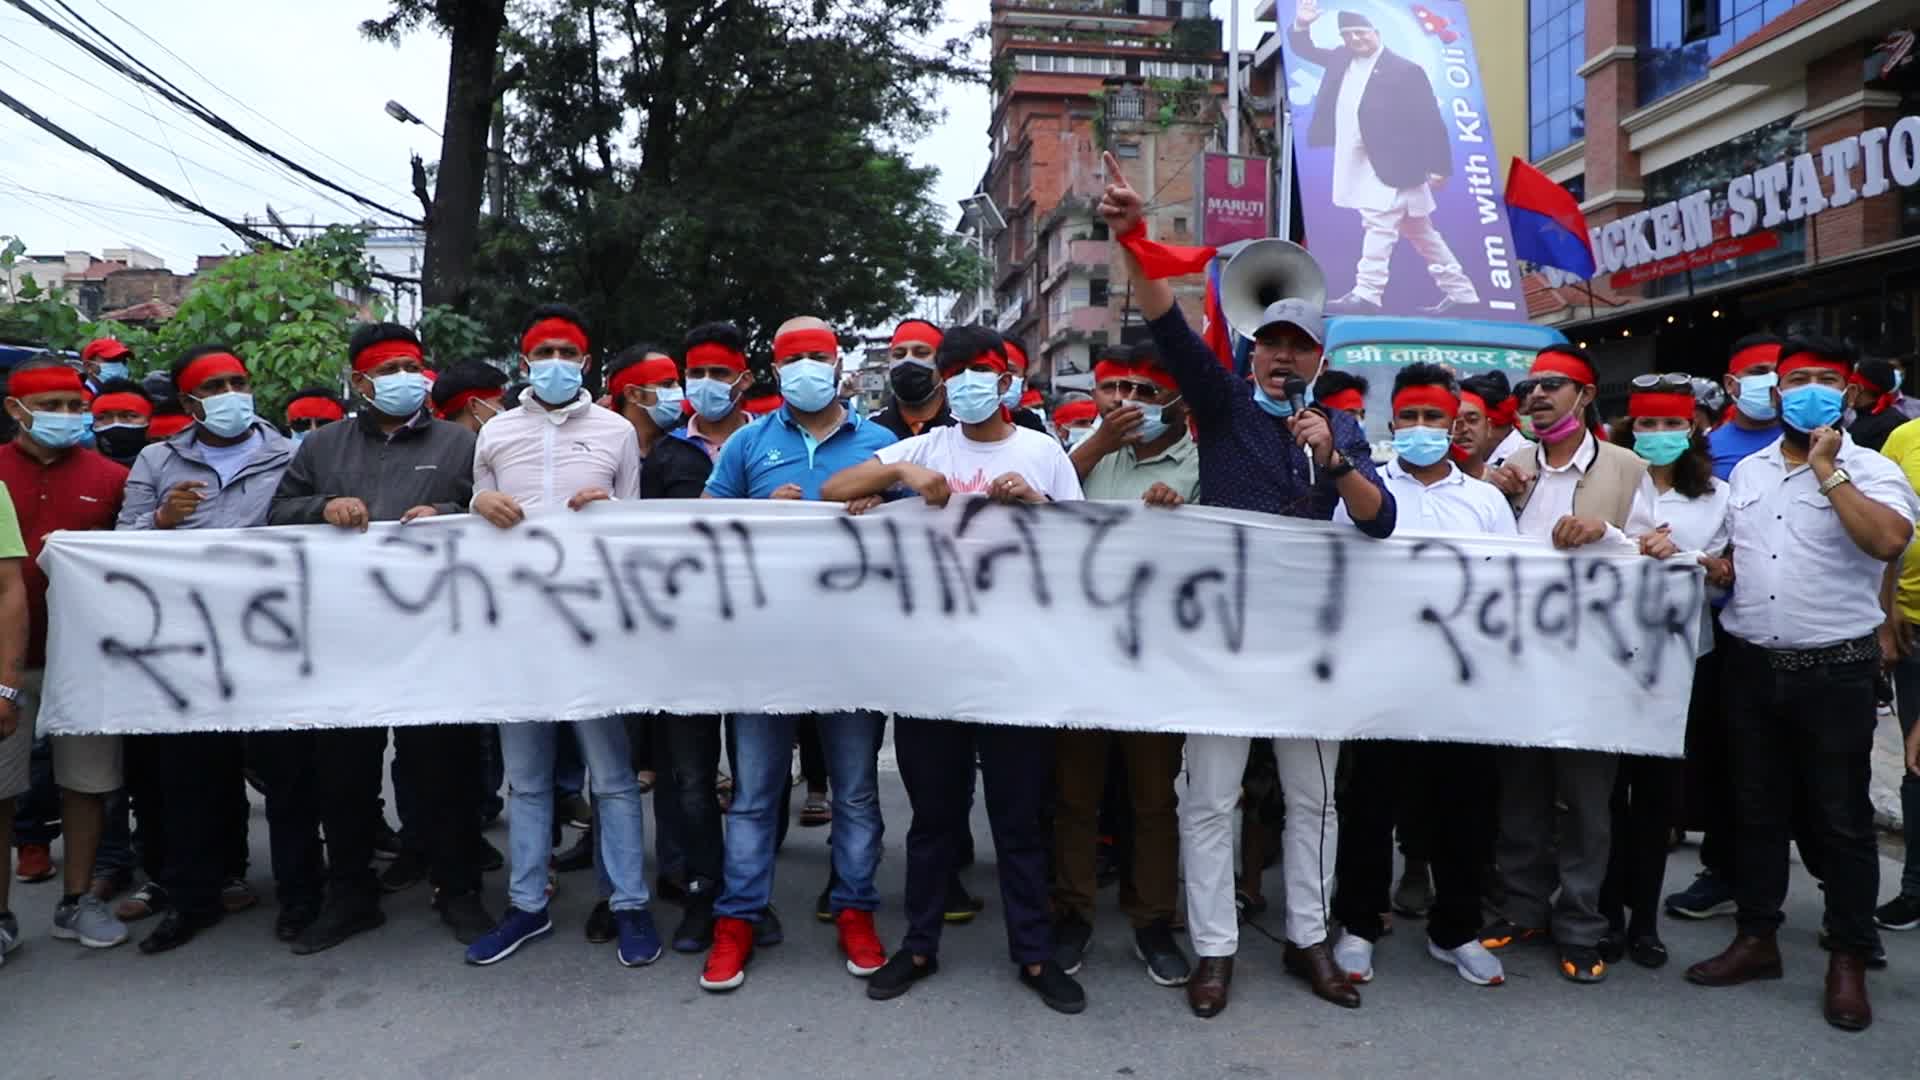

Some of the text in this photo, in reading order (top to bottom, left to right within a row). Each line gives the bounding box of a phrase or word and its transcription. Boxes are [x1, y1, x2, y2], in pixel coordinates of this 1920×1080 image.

[1440, 47, 1516, 311] I am with KP Oli
[1207, 197, 1264, 216] MARUTI
[1345, 345, 1382, 364] श्री
